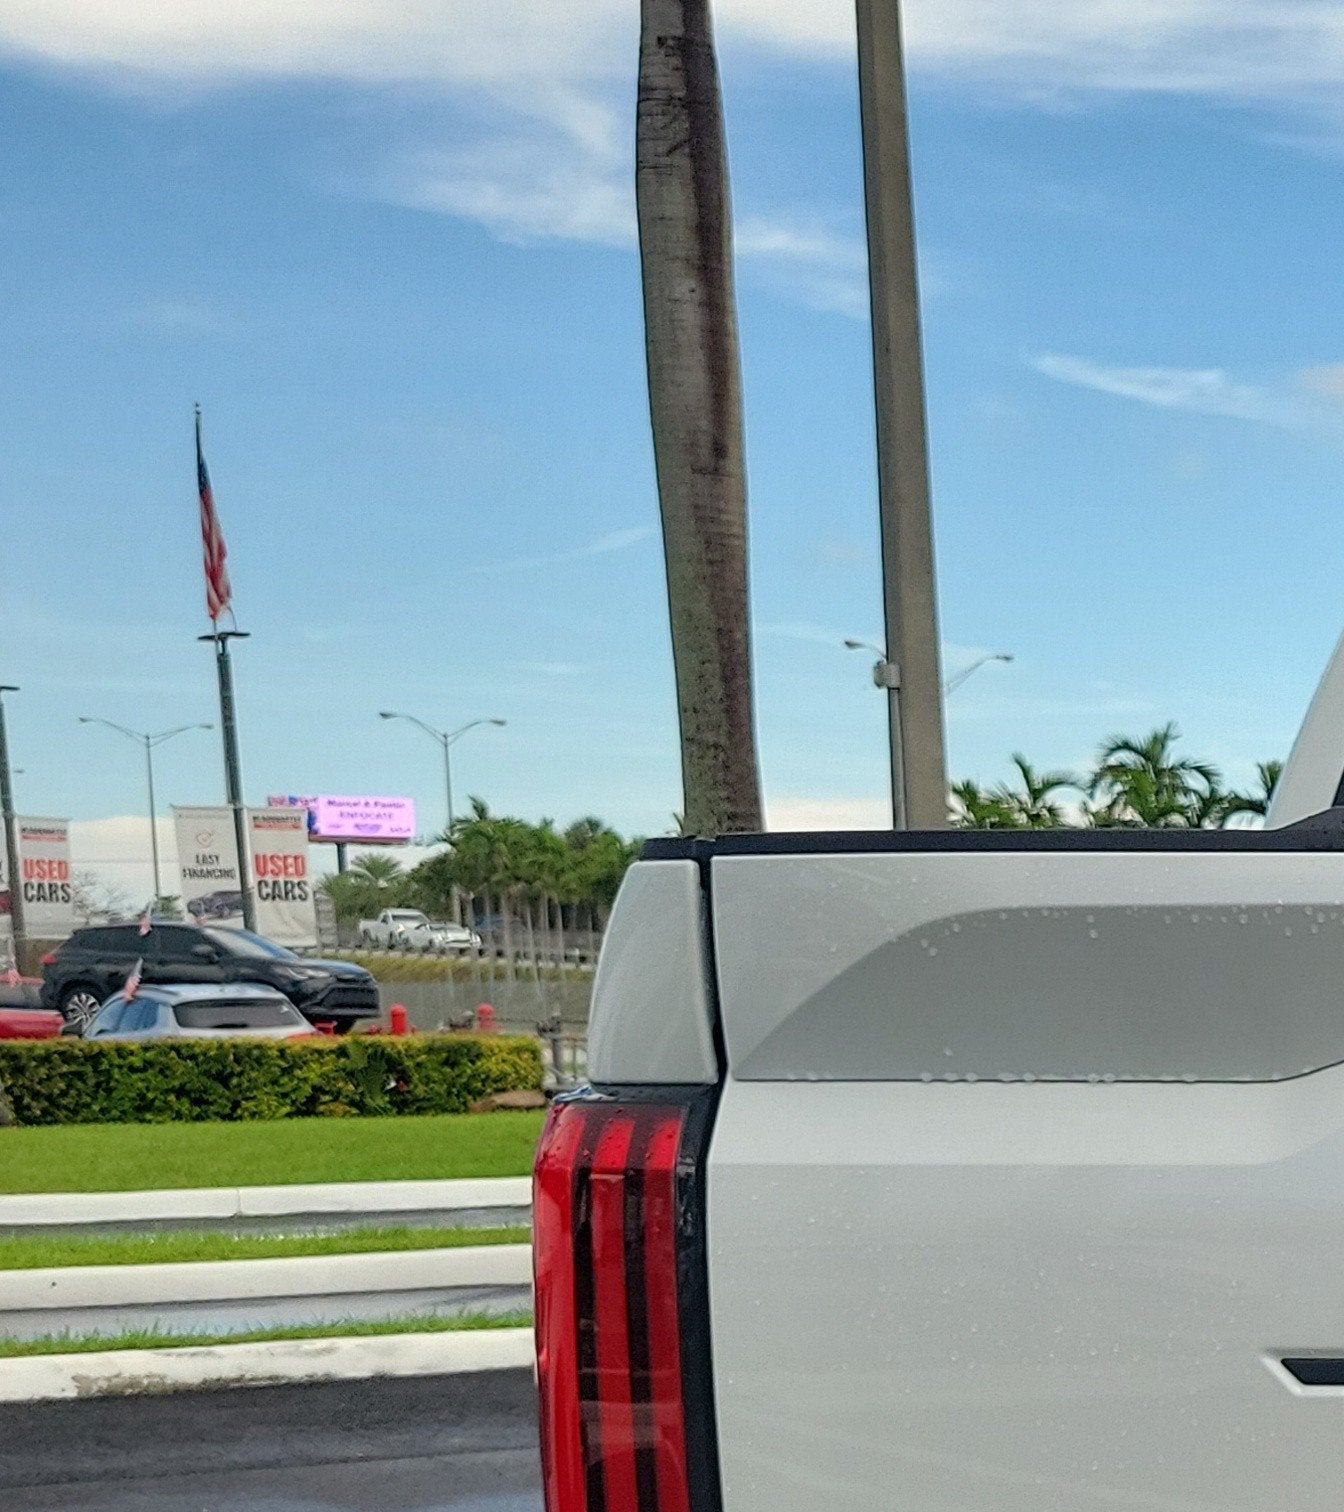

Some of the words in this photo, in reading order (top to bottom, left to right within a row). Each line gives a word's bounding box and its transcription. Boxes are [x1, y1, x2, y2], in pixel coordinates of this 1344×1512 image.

[23, 858, 69, 880] USED
[254, 853, 306, 877] USED
[23, 882, 71, 902] CARS
[257, 879, 309, 901] CARS
